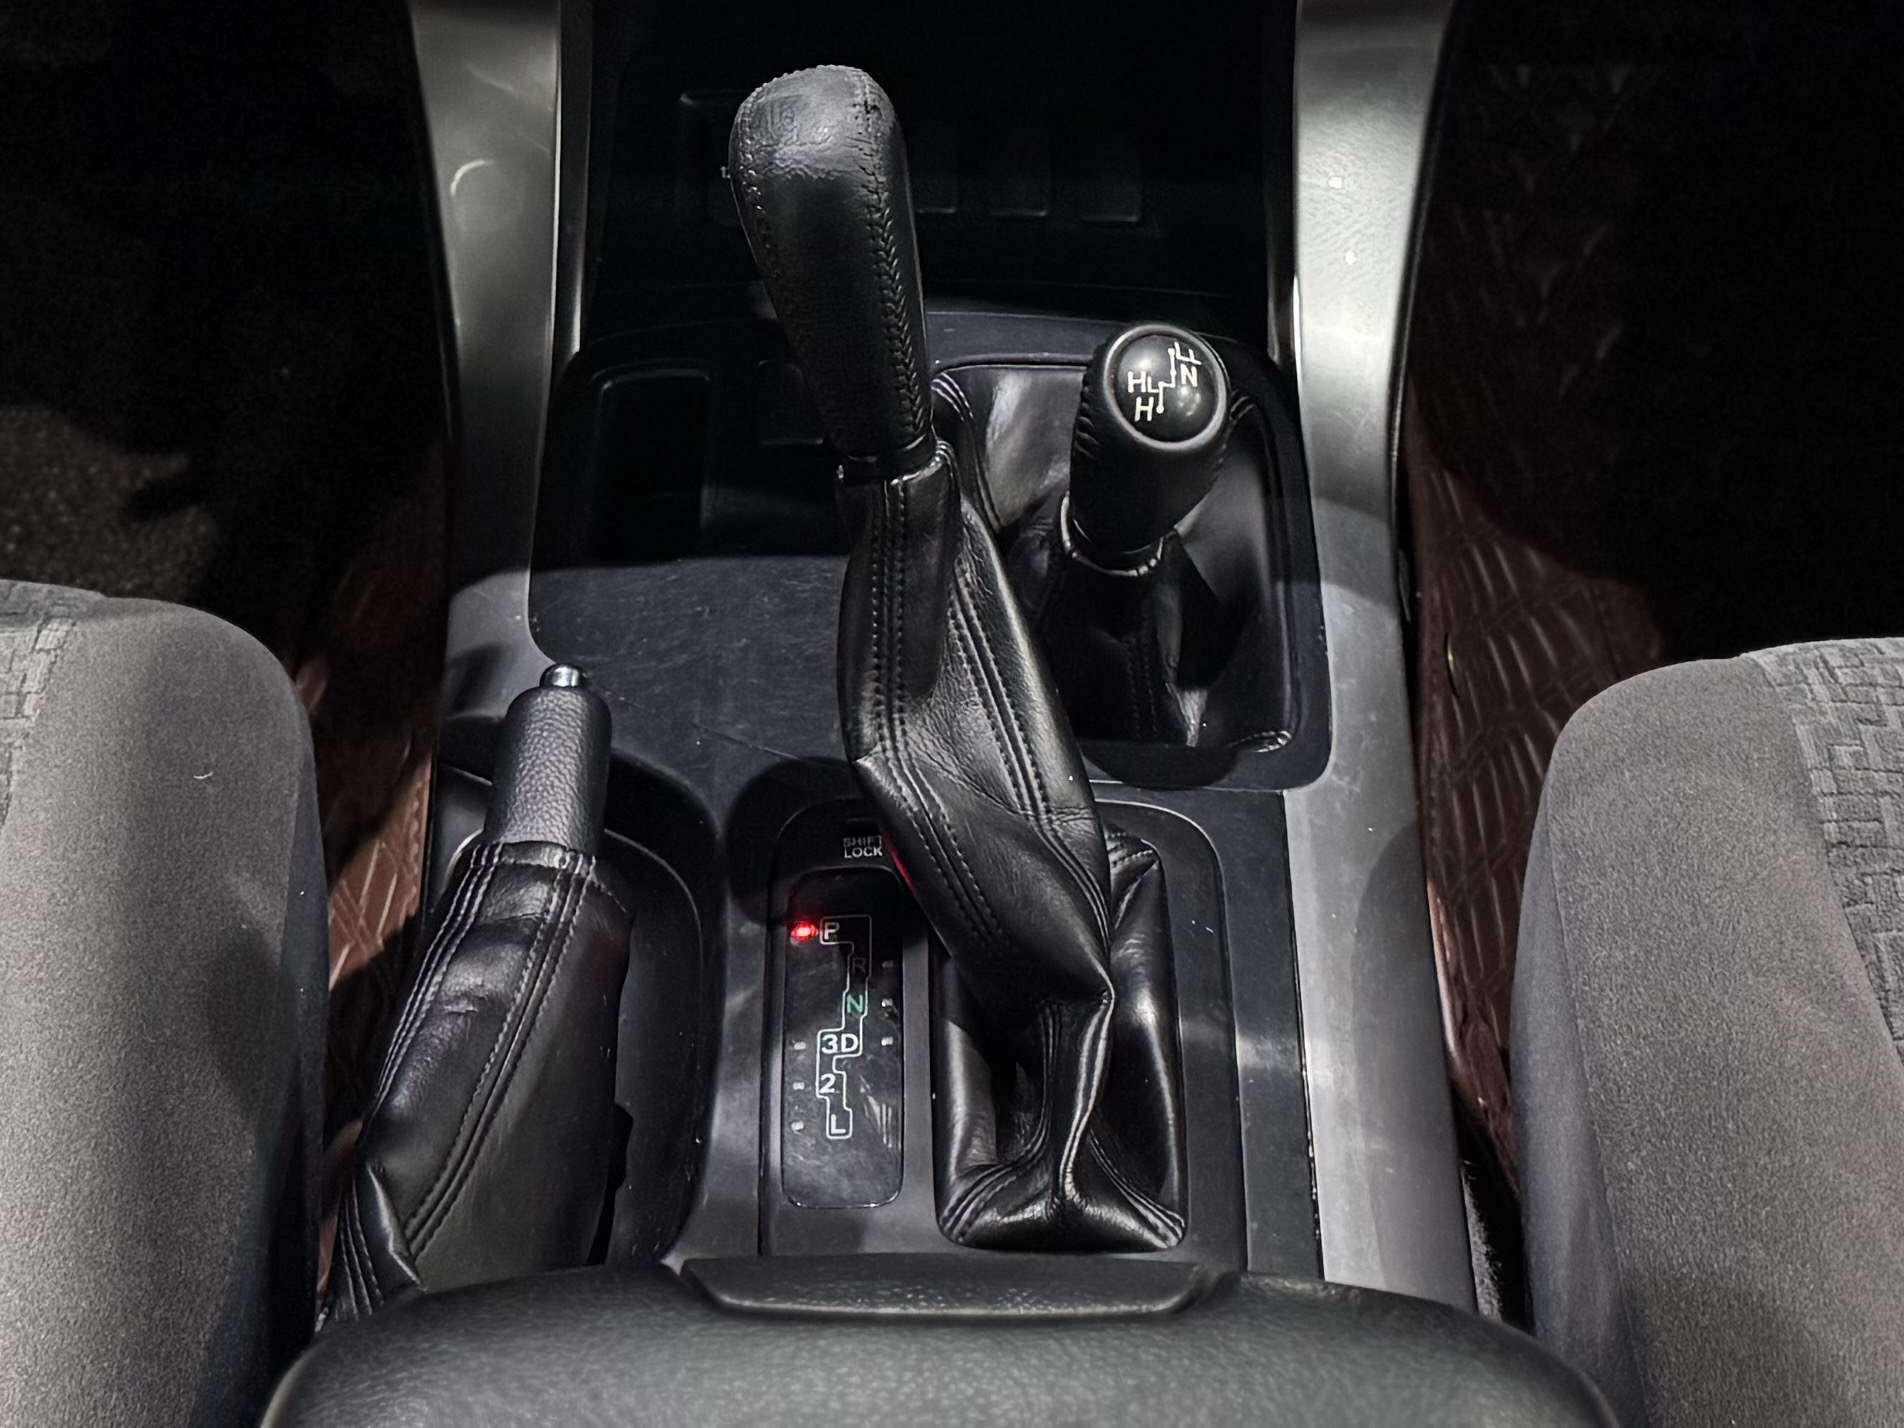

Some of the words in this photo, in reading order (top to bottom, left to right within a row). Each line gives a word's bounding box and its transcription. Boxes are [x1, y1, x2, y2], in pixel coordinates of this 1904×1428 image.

[1180, 363, 1198, 387] N
[1134, 396, 1155, 422] H
[844, 846, 883, 859] LOCK
[824, 921, 841, 940] P
[846, 994, 865, 1013] N
[819, 1073, 836, 1094] 2
[830, 1114, 846, 1135] L
